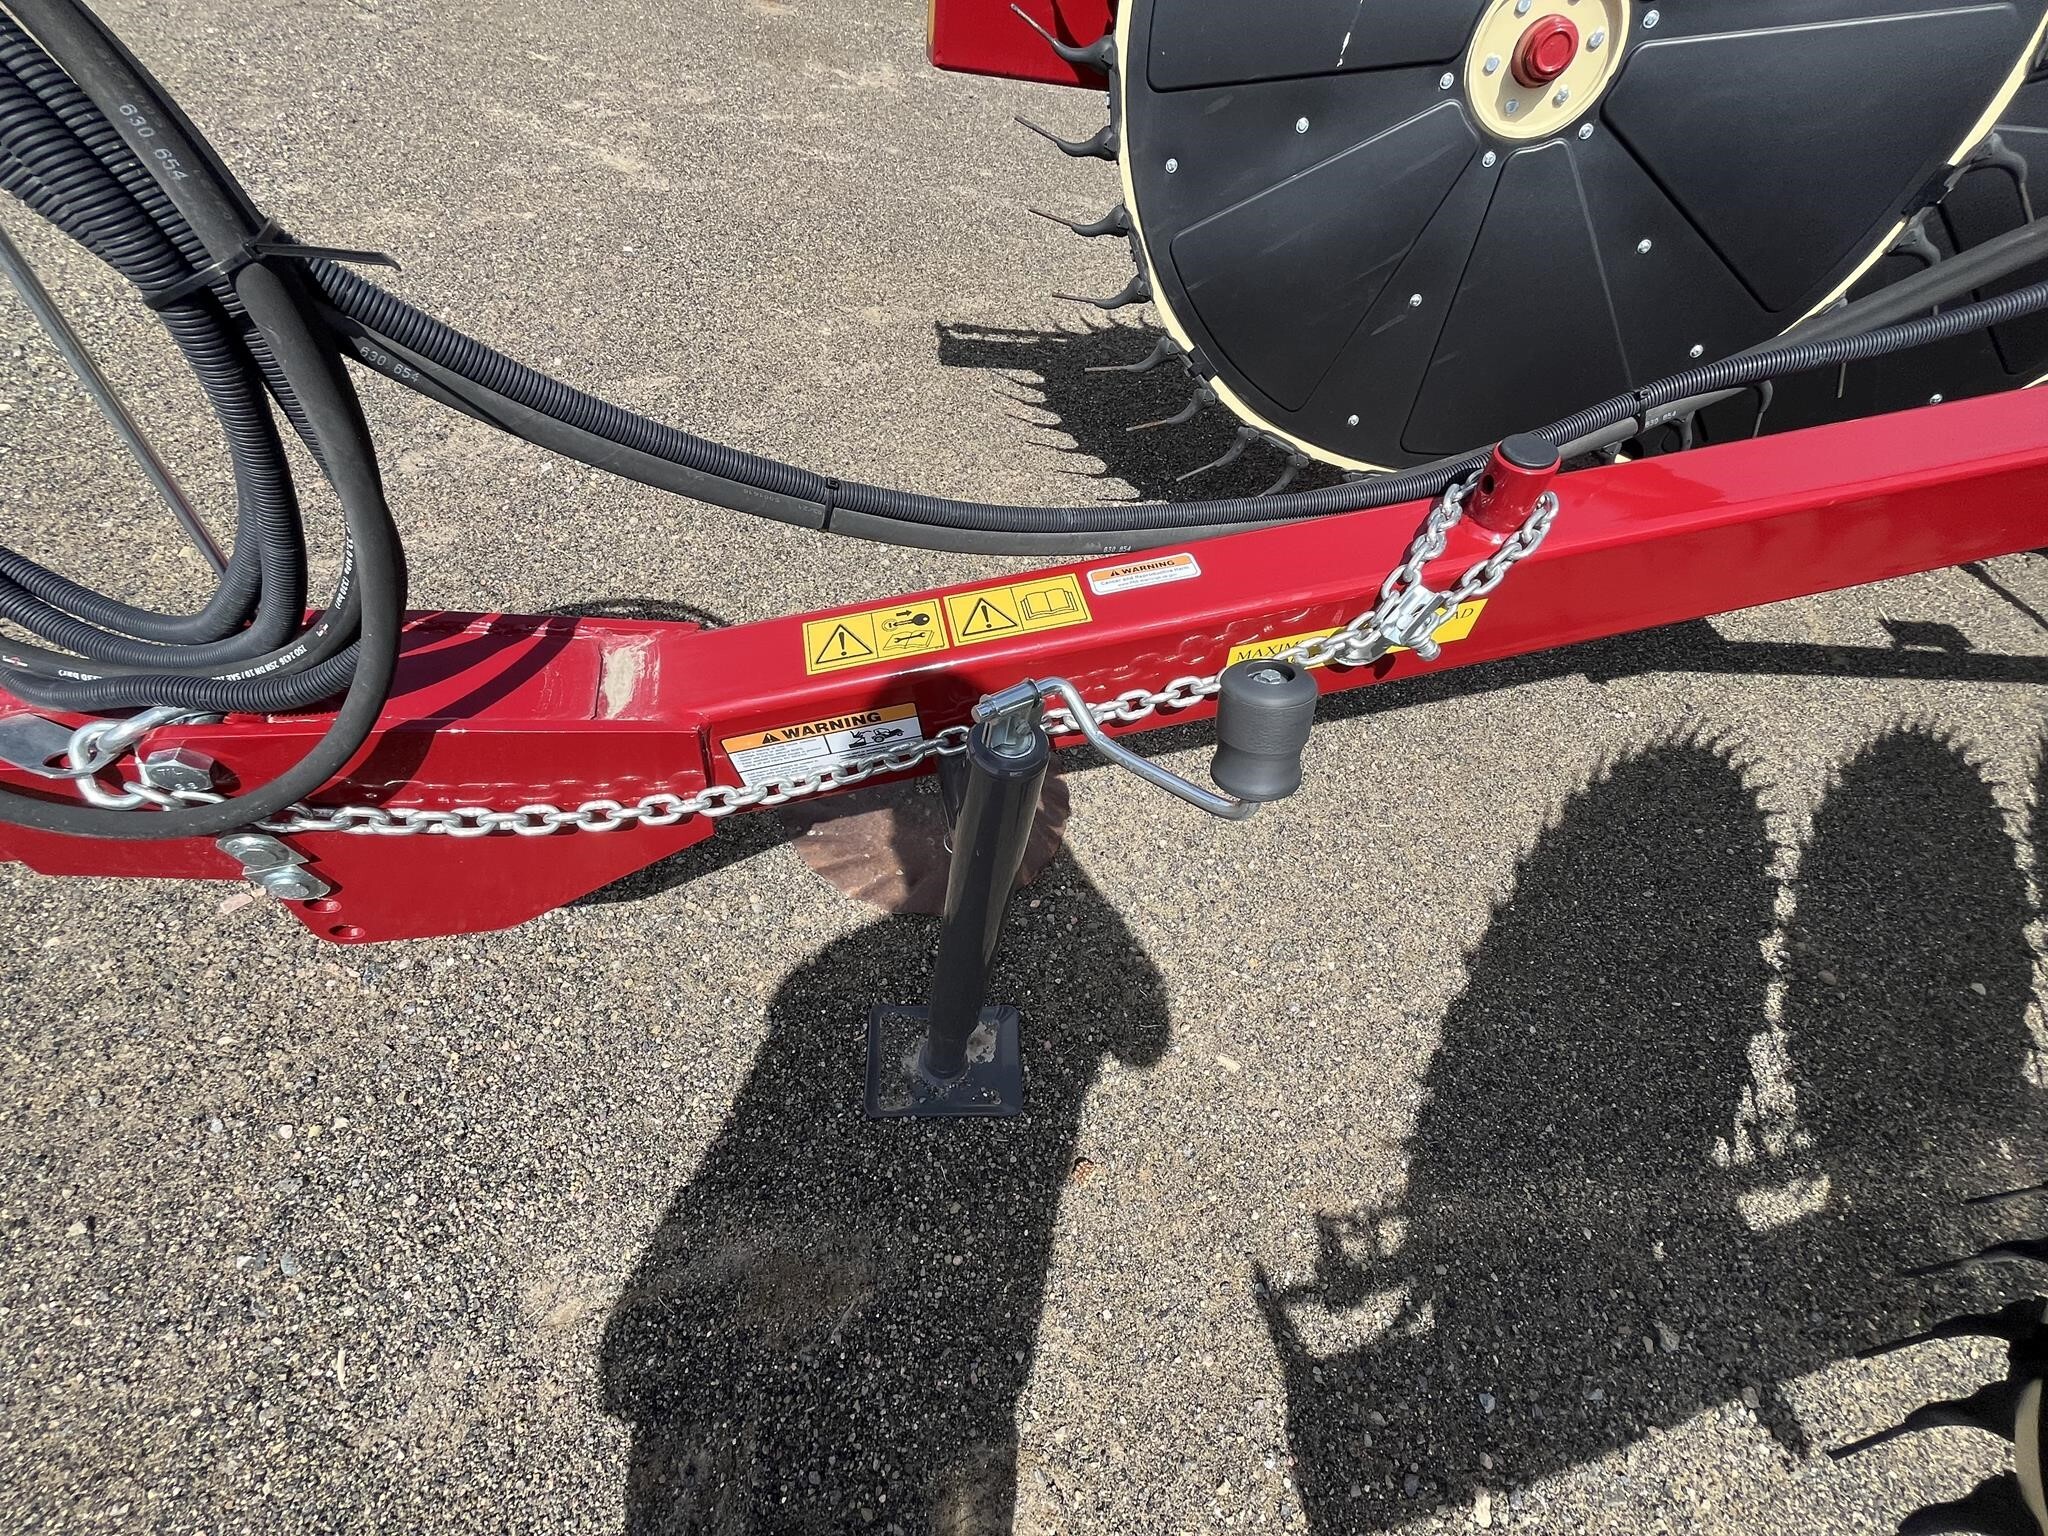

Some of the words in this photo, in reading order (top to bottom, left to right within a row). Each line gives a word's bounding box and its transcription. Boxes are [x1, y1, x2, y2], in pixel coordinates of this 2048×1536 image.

[119, 103, 155, 139] 630
[153, 148, 189, 182] 654
[360, 346, 387, 366] 630
[393, 363, 420, 383] 654
[1121, 559, 1175, 575] WARNING
[294, 644, 308, 657] ISO
[278, 653, 296, 666] 1436
[57, 669, 80, 680] bar)
[254, 665, 267, 676] DN
[780, 711, 882, 740] WARNING
